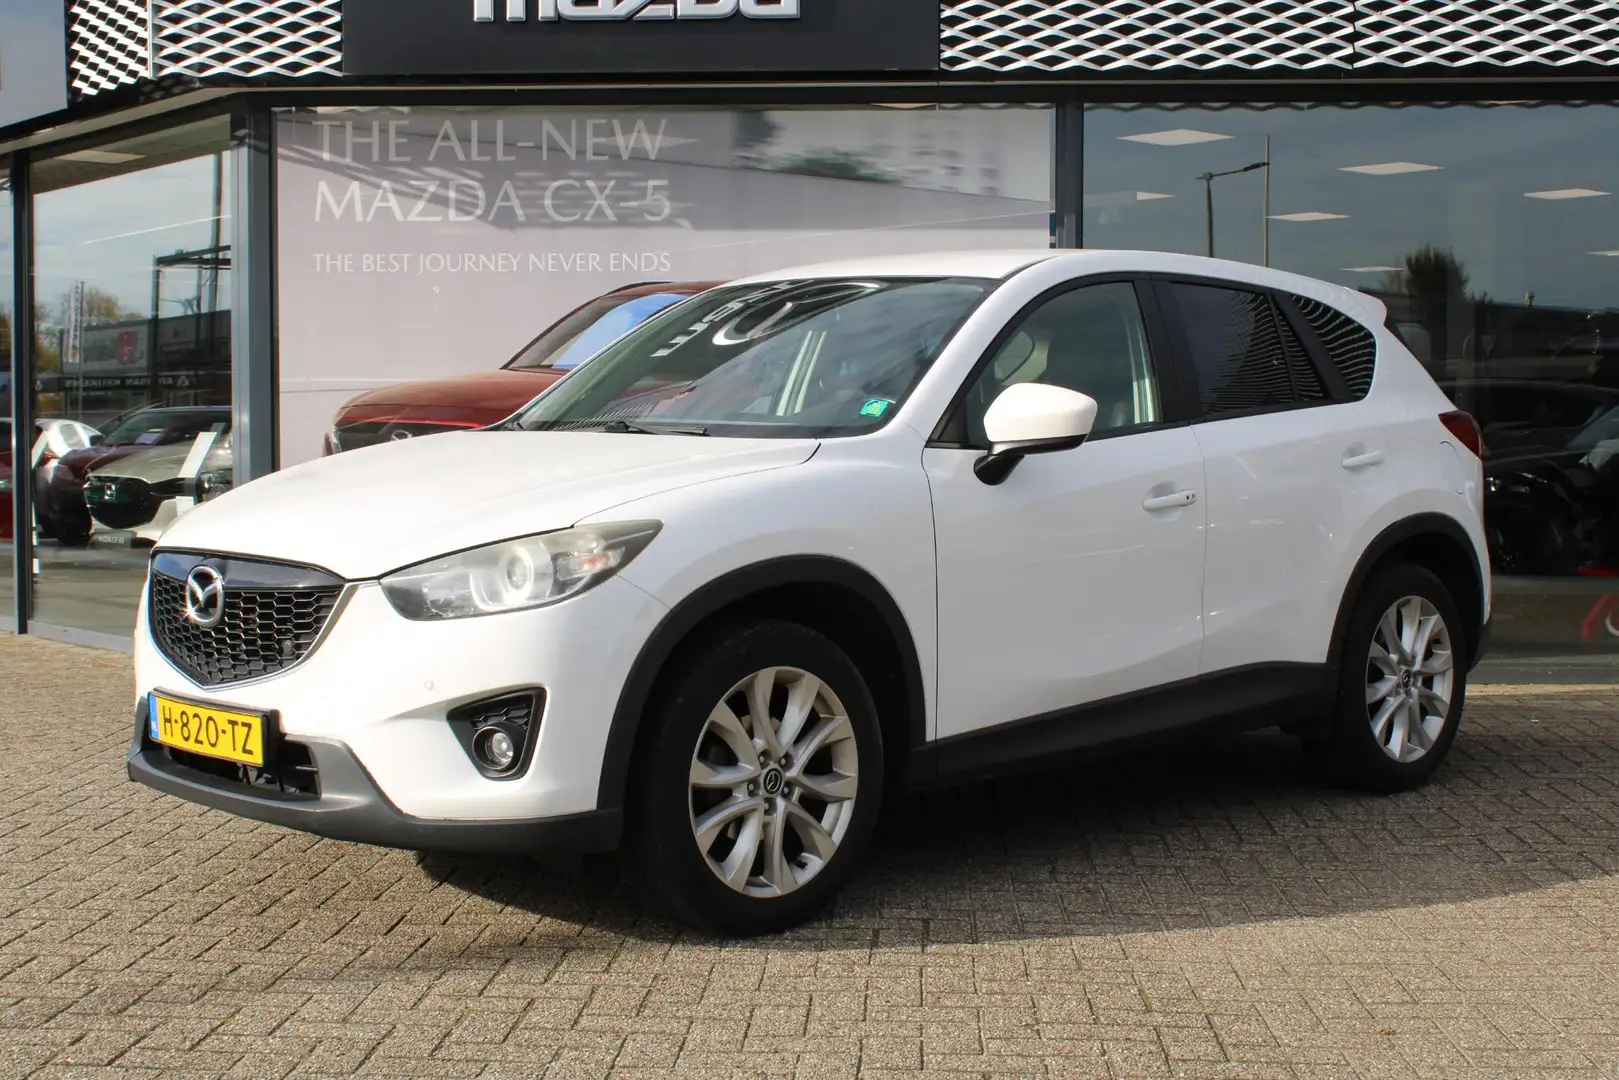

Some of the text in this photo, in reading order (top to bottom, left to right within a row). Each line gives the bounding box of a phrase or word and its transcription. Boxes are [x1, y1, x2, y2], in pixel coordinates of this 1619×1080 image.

[311, 118, 668, 162] THE ALL-NEW
[314, 179, 671, 222] MAZDA CX-5
[313, 252, 671, 275] THE BEST JOURNEY NEVER ENDS
[162, 705, 254, 755] H-820-TZ
